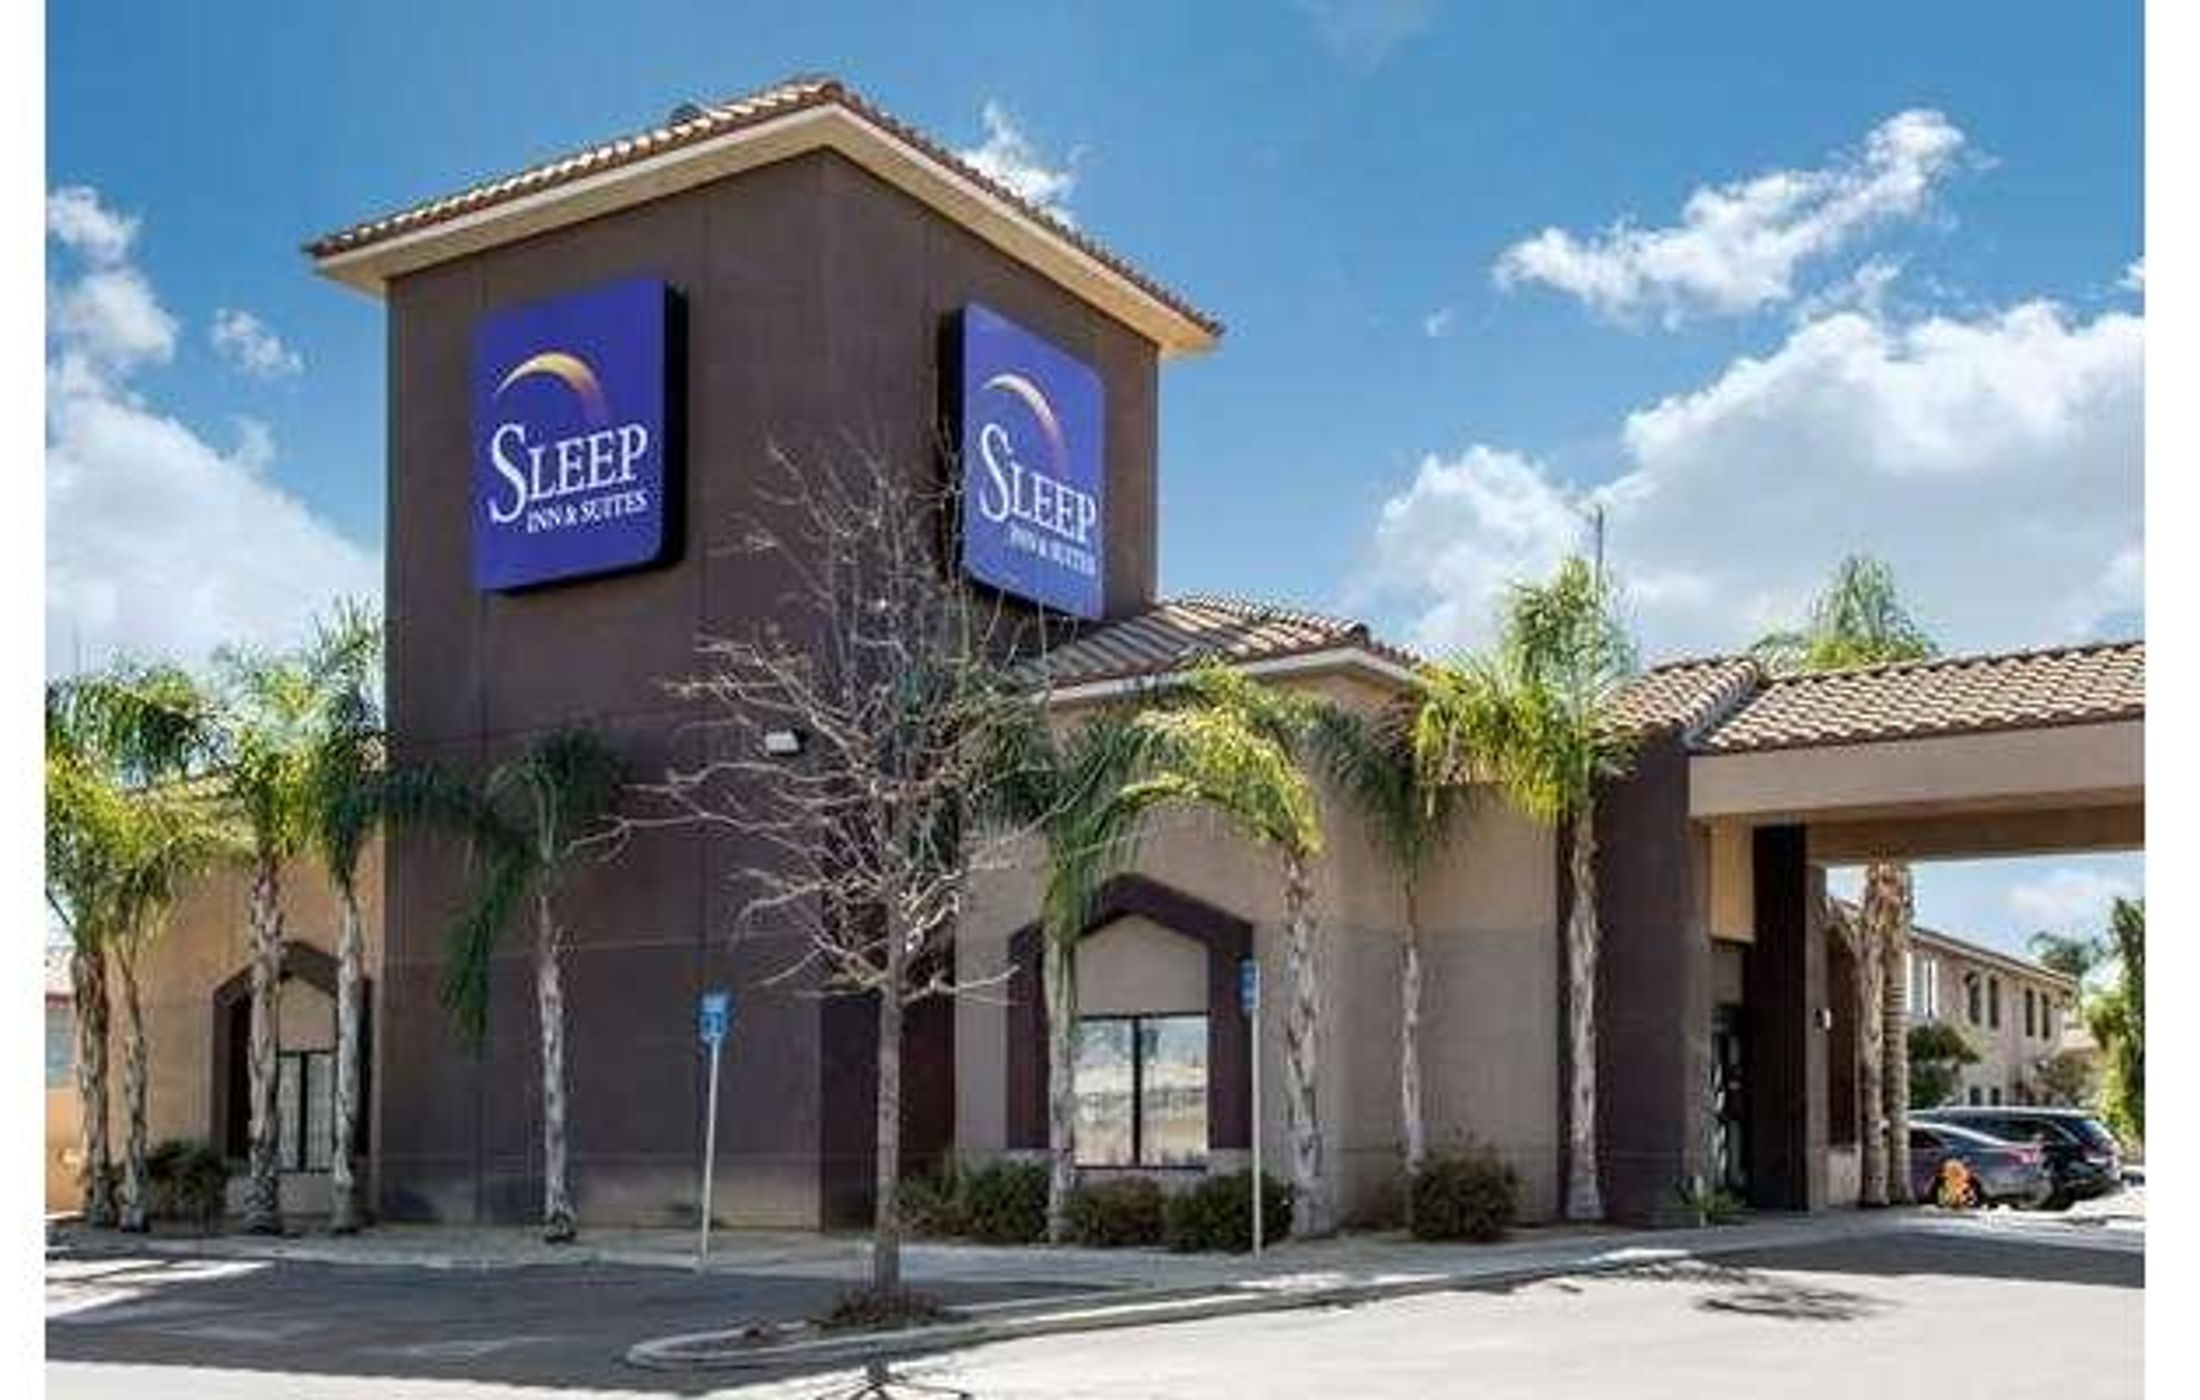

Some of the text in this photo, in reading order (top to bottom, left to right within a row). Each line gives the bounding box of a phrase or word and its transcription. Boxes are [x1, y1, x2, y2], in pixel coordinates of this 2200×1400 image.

[488, 422, 649, 524] SLEEP
[527, 505, 562, 533] INN
[580, 489, 648, 524] SUITES
[978, 423, 1097, 544] SLEEP
